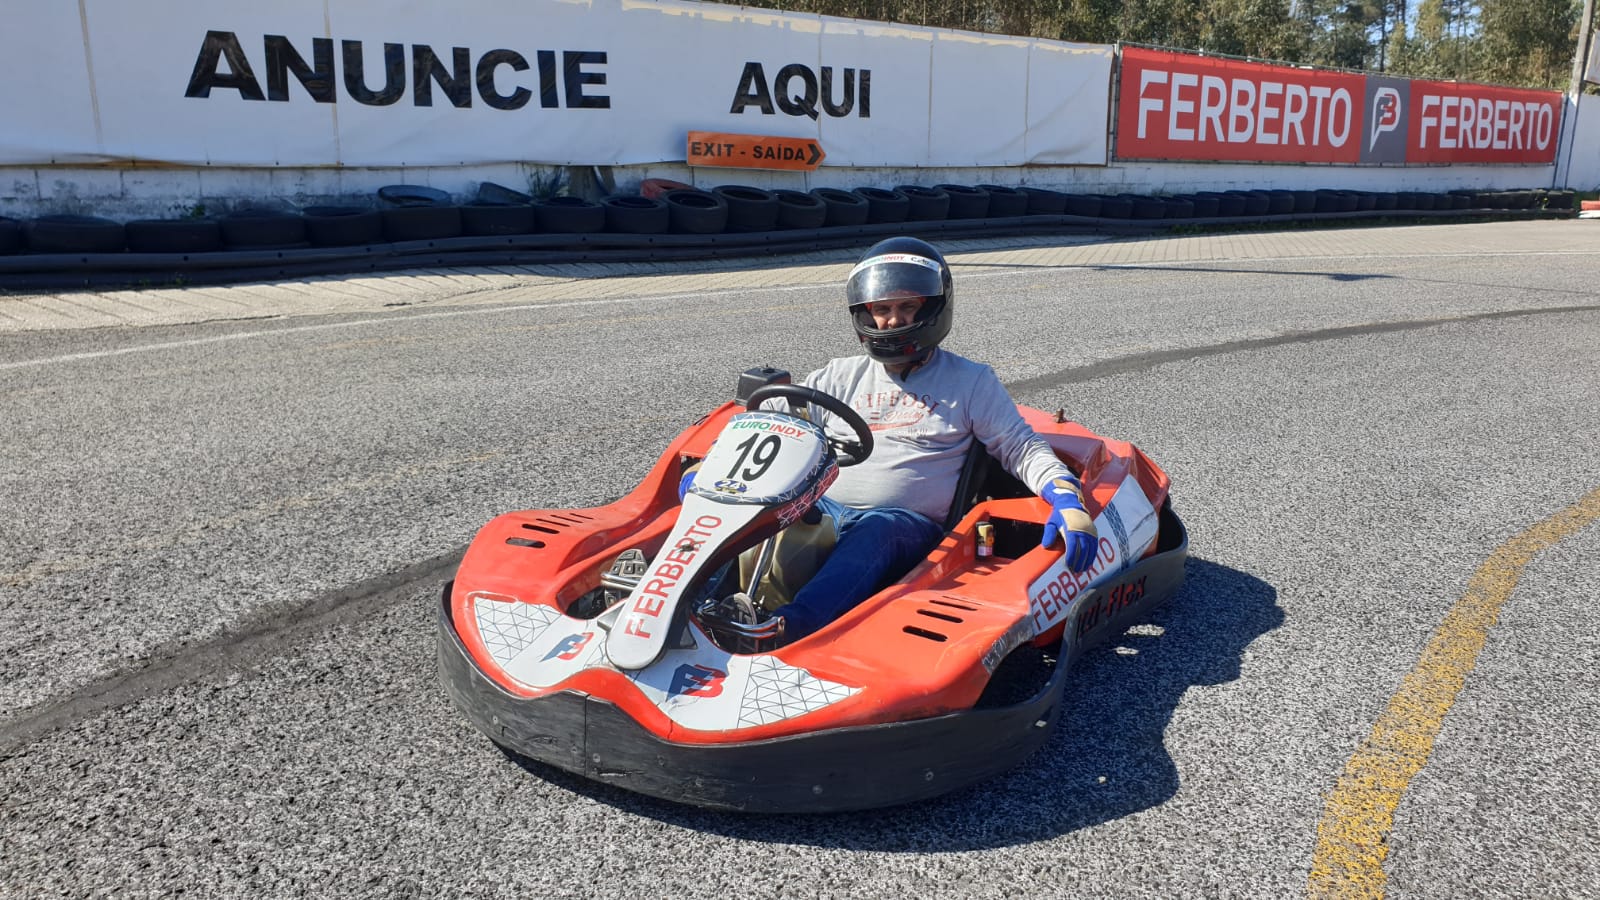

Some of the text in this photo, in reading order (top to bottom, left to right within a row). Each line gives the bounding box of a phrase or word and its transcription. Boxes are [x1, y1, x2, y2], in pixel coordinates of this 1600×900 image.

[185, 30, 872, 120] ANUNCIE AQUI
[1137, 69, 1352, 148] FERBERTO
[1420, 95, 1554, 151] FERBERTO
[691, 142, 735, 157] EXIT
[753, 144, 806, 161] SAÍDA
[727, 433, 781, 482] 19
[732, 421, 807, 438] EUROINDY
[624, 514, 722, 639] FERBERTO
